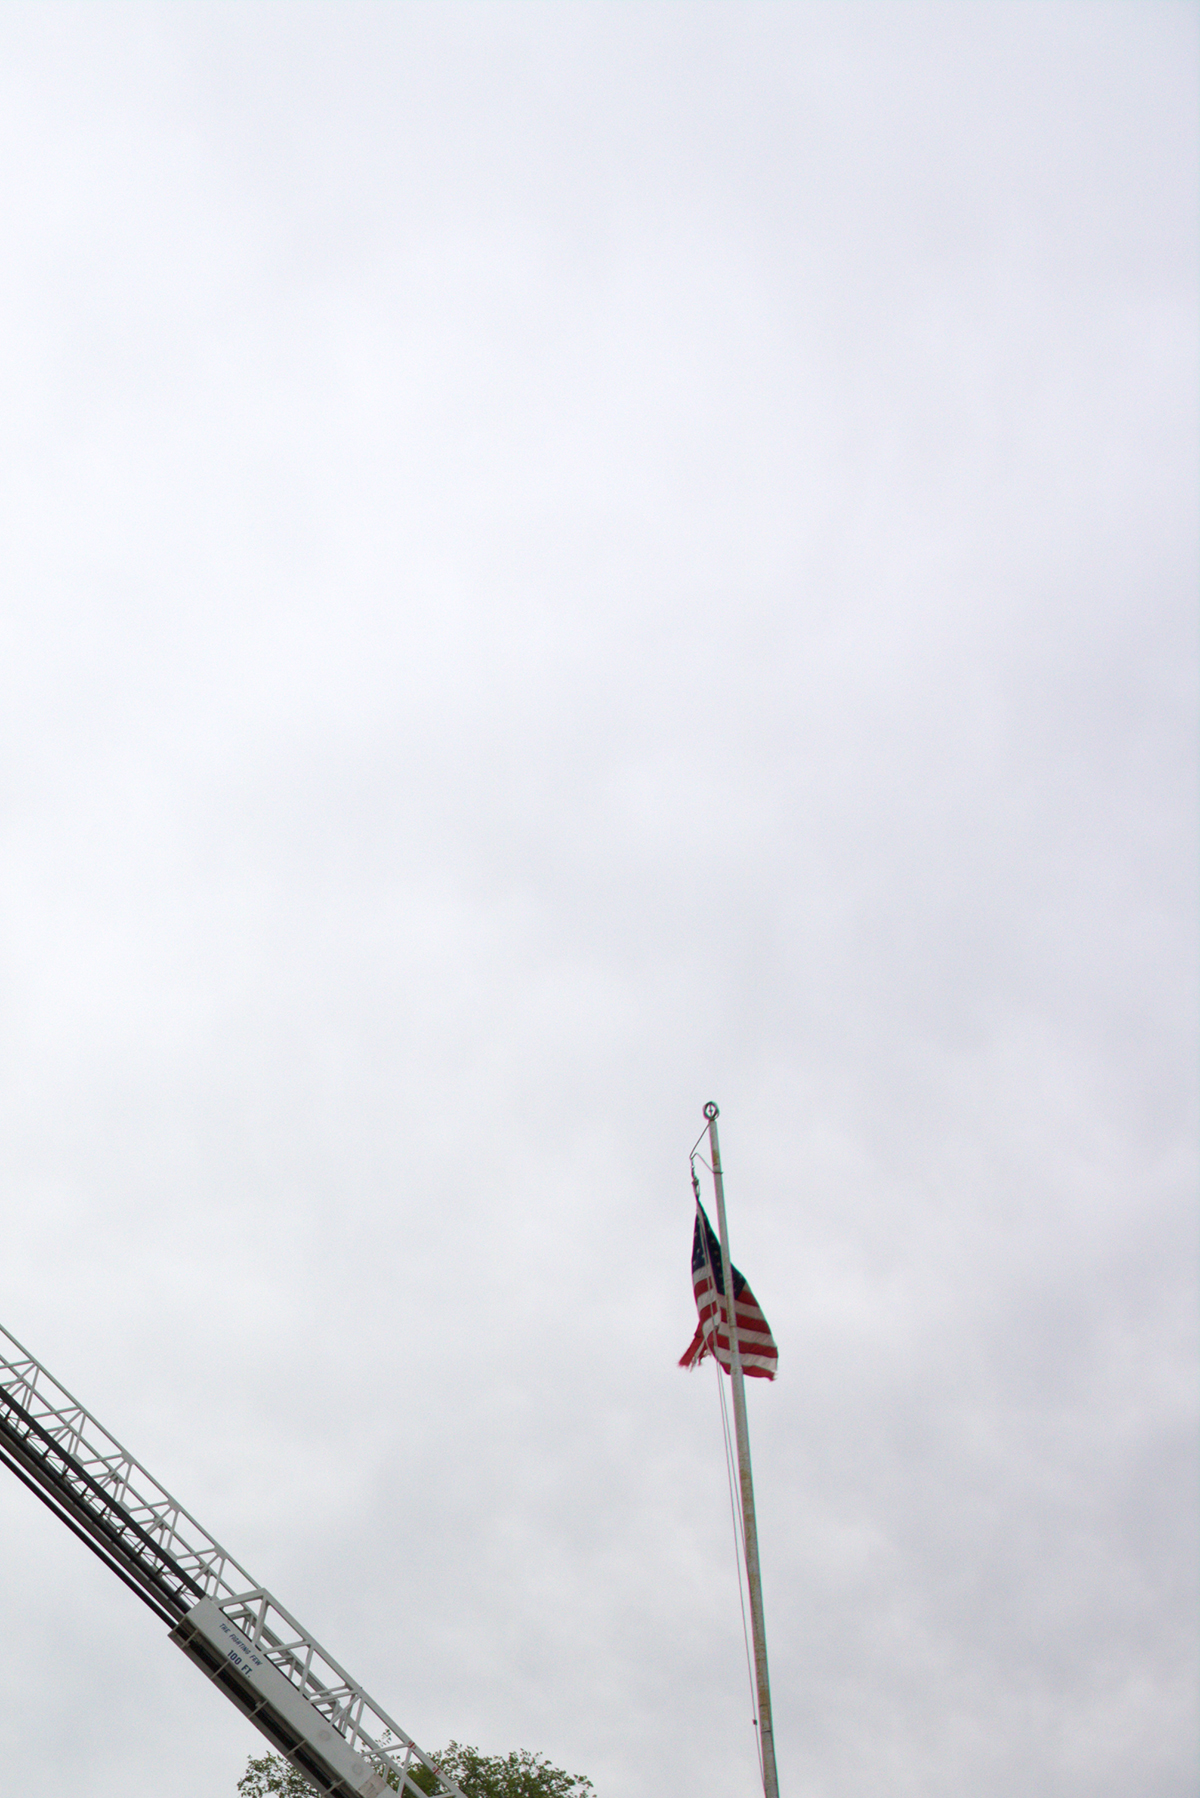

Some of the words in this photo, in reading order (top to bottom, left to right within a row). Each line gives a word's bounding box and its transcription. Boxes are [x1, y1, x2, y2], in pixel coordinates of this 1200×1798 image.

[219, 1623, 231, 1633] THE
[229, 1633, 251, 1654] FIGHTING
[249, 1654, 262, 1666] FEW
[227, 1649, 242, 1665] 100
[241, 1664, 252, 1678] FT.
